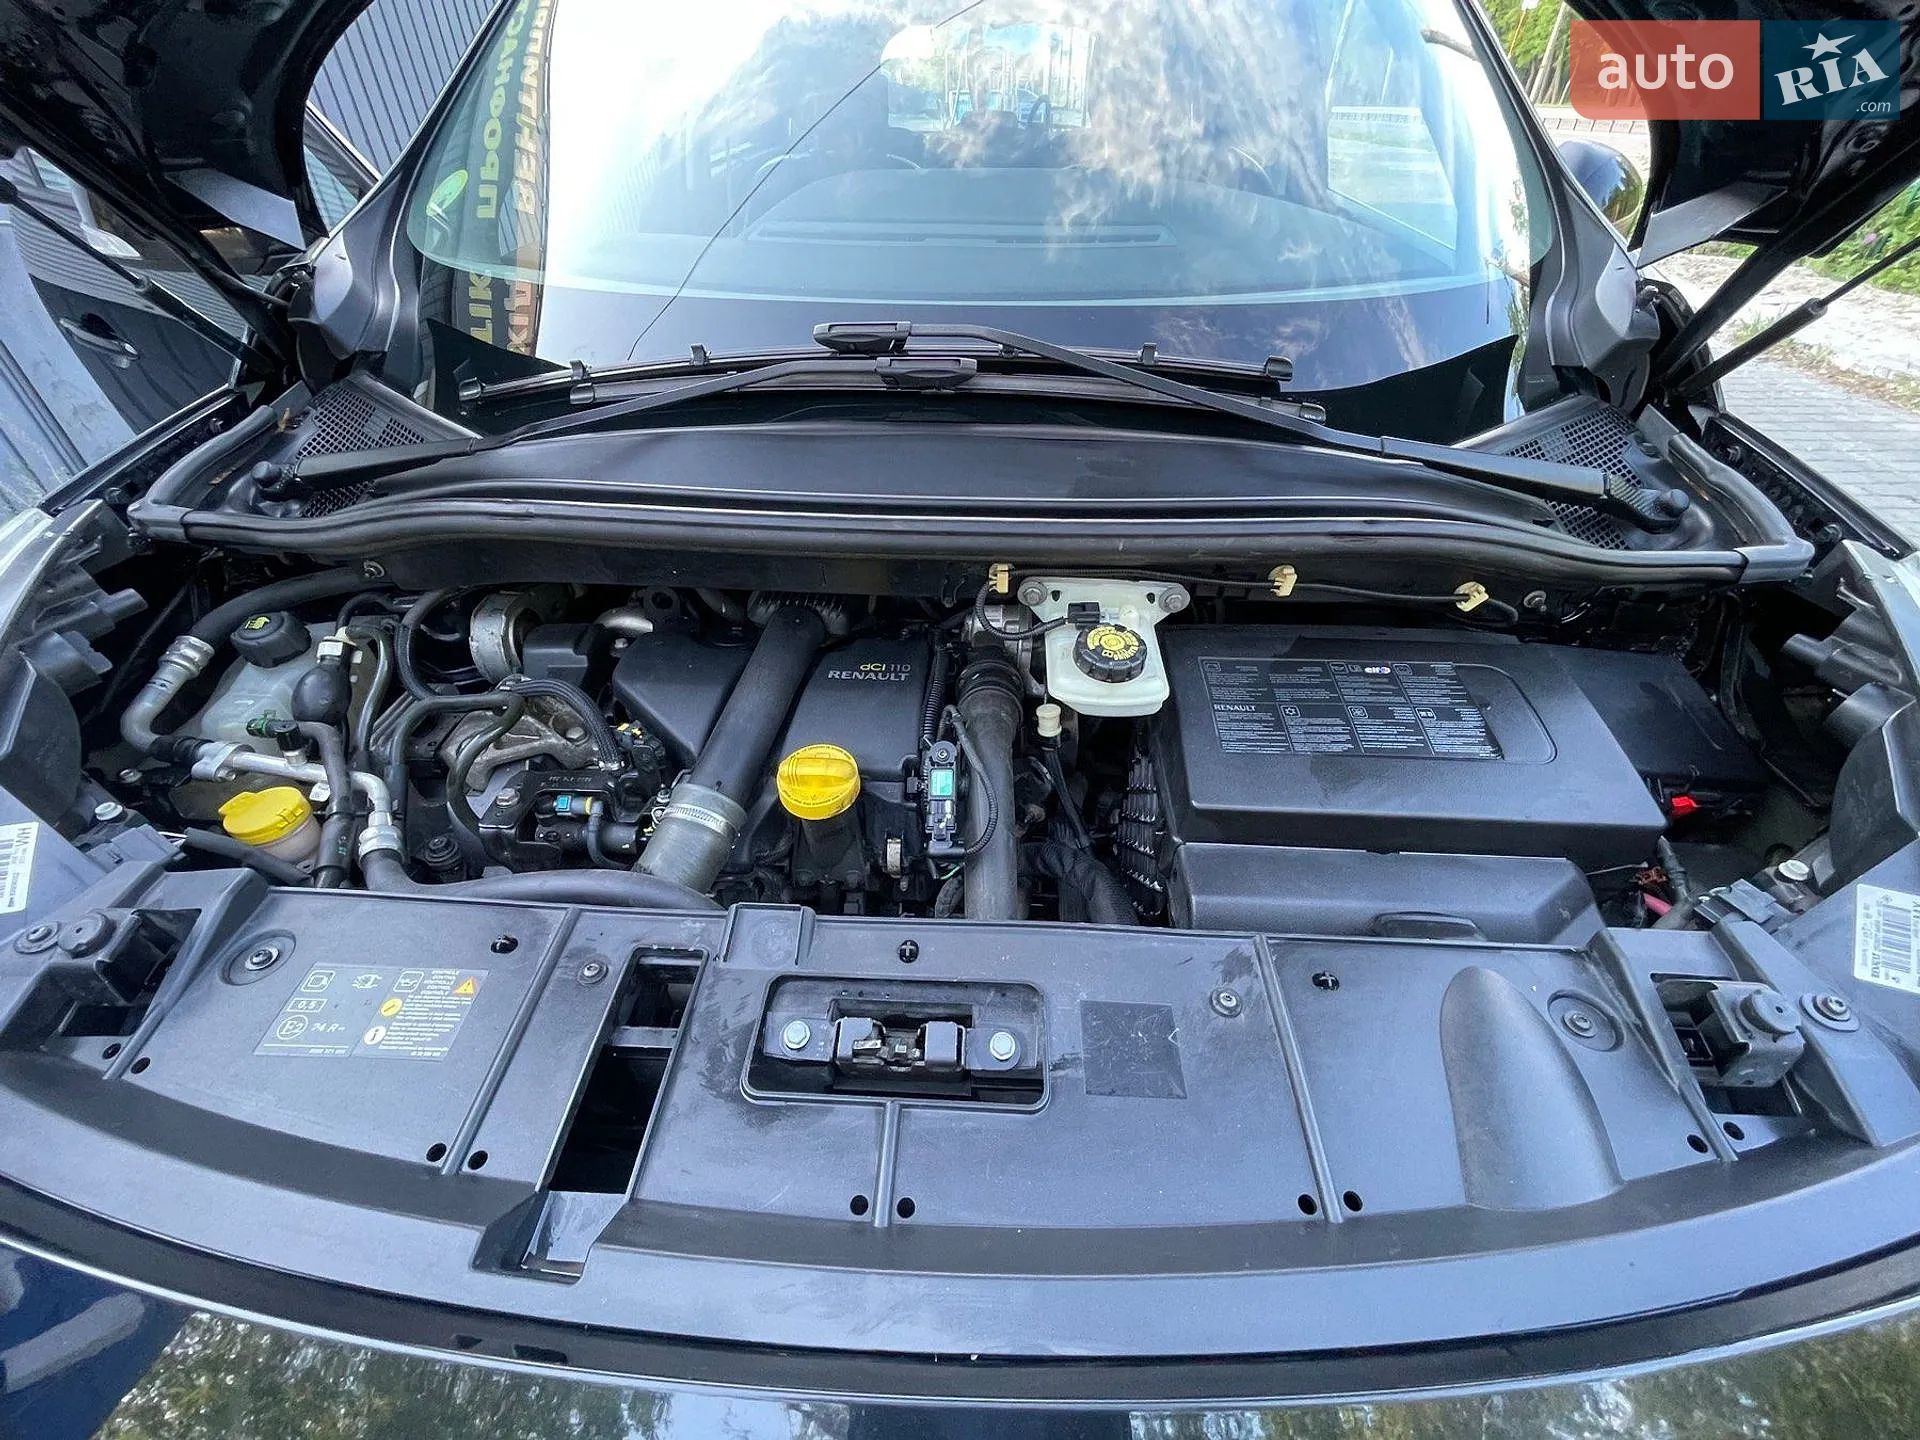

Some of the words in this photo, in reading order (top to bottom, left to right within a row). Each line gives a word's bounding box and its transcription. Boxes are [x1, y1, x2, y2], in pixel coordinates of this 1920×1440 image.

[890, 663, 911, 672] 110
[827, 670, 910, 682] RENAULT
[1213, 703, 1256, 713] RENAULT
